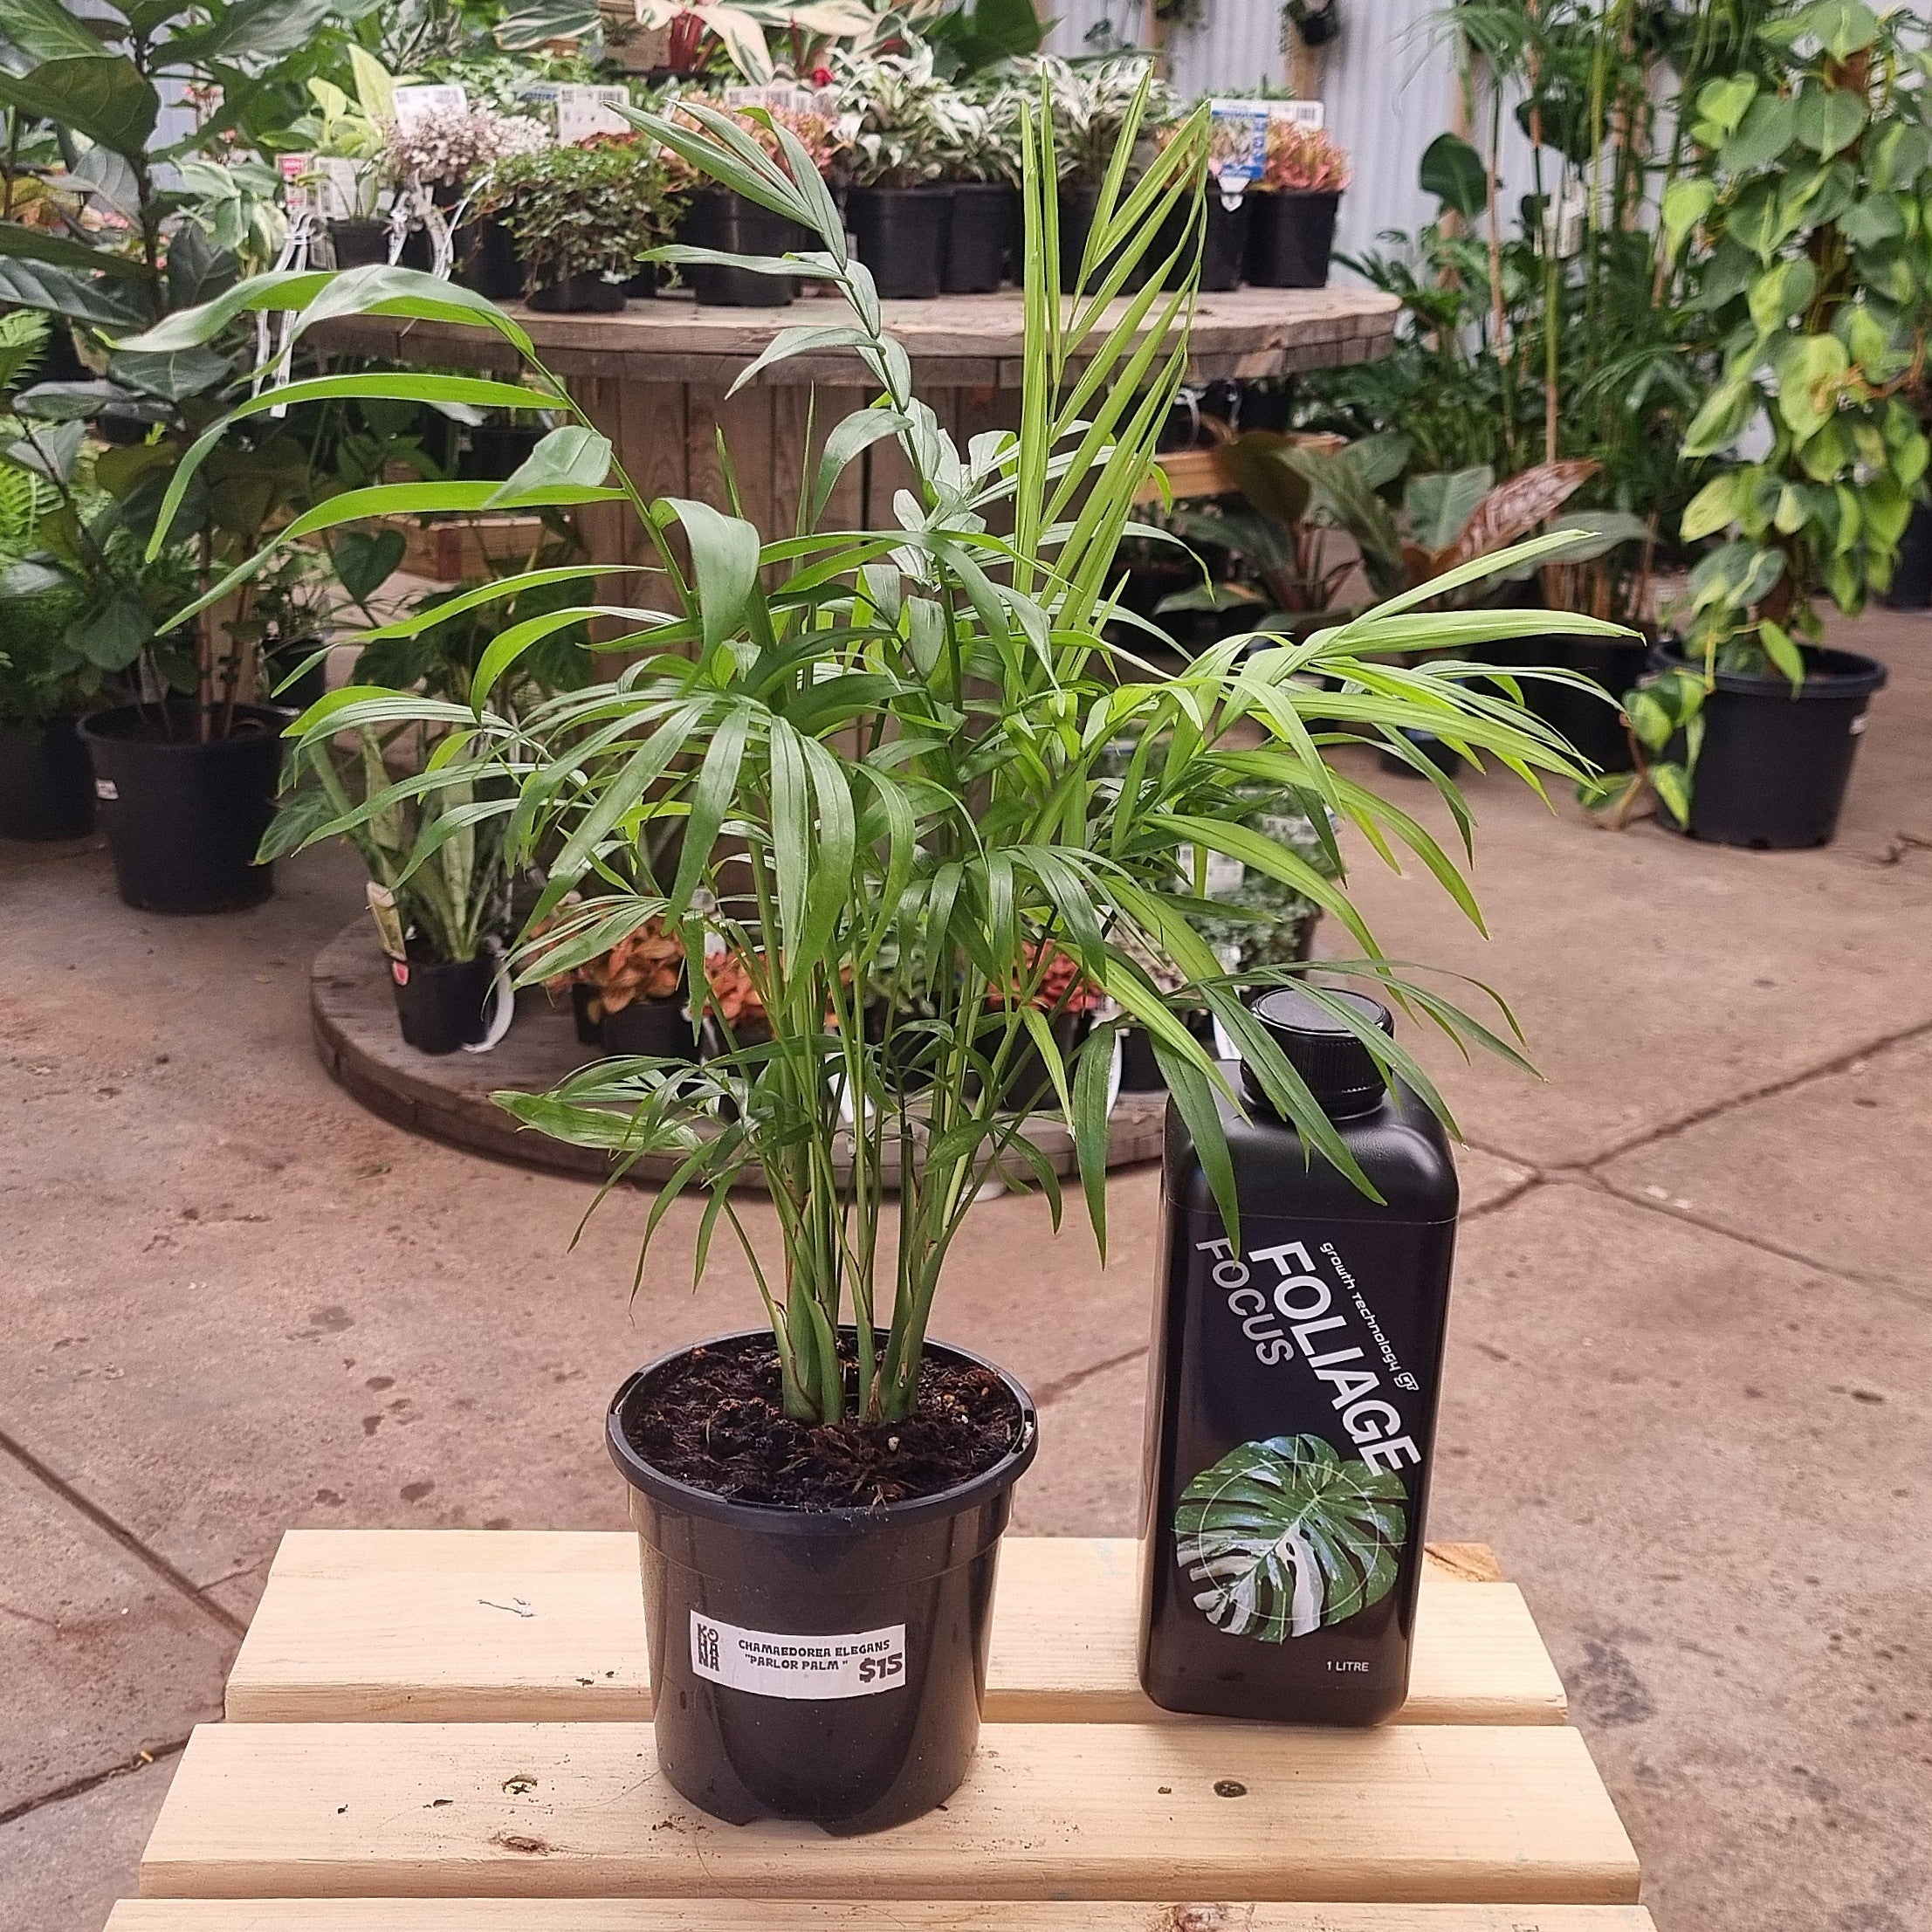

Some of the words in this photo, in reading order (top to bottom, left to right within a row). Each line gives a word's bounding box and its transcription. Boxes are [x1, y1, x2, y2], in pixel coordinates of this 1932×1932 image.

[1319, 1241, 1355, 1289] growth
[1195, 1238, 1294, 1365] FOCUS
[1248, 1241, 1421, 1476] FOLIAGE
[739, 1640, 831, 1658] CHAMAEDOREA
[835, 1640, 890, 1656] ELEGANS
[859, 1653, 903, 1682] $15
[1326, 1660, 1332, 1671] 1
[1336, 1660, 1369, 1672] LITRE
